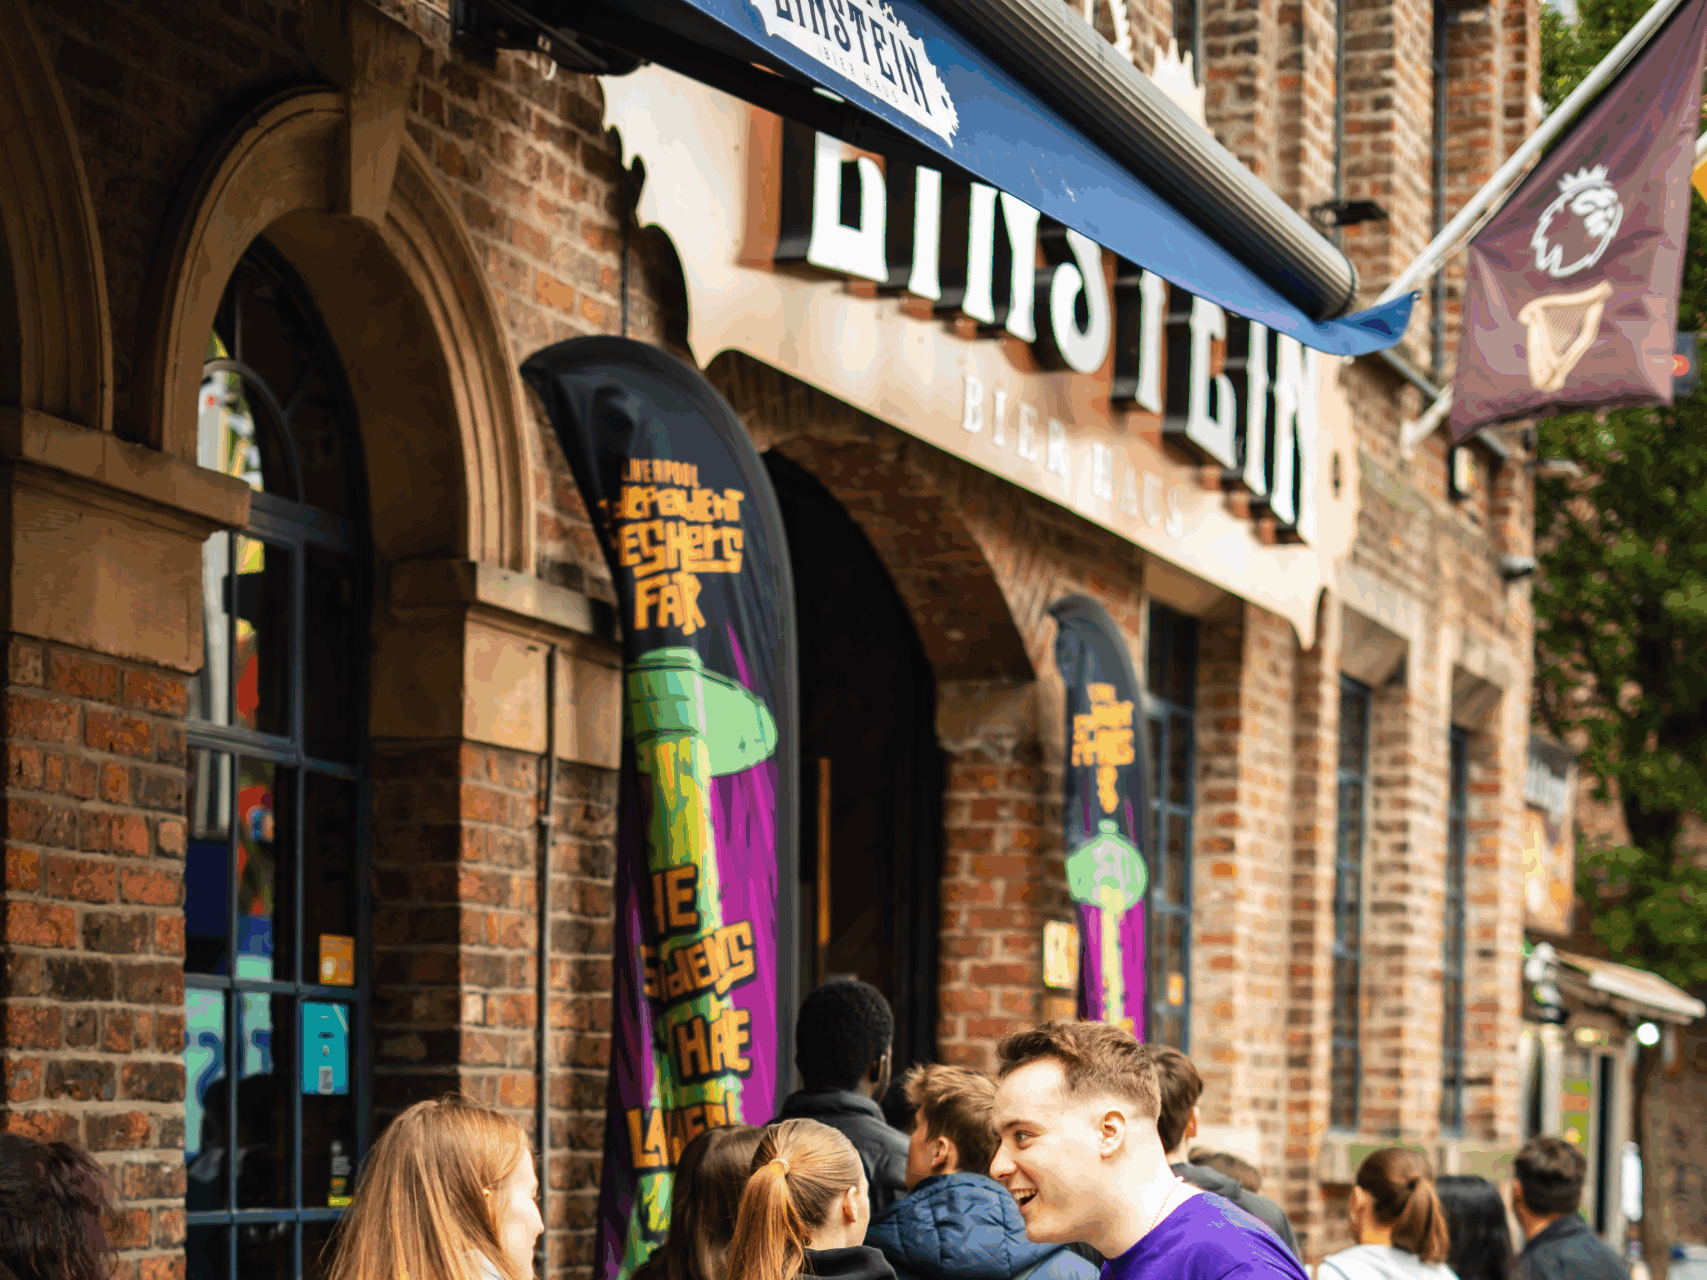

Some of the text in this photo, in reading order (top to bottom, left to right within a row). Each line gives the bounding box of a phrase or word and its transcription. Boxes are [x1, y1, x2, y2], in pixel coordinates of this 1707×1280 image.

[823, 46, 899, 104] BIER HAUS
[960, 374, 1068, 478] BIER
